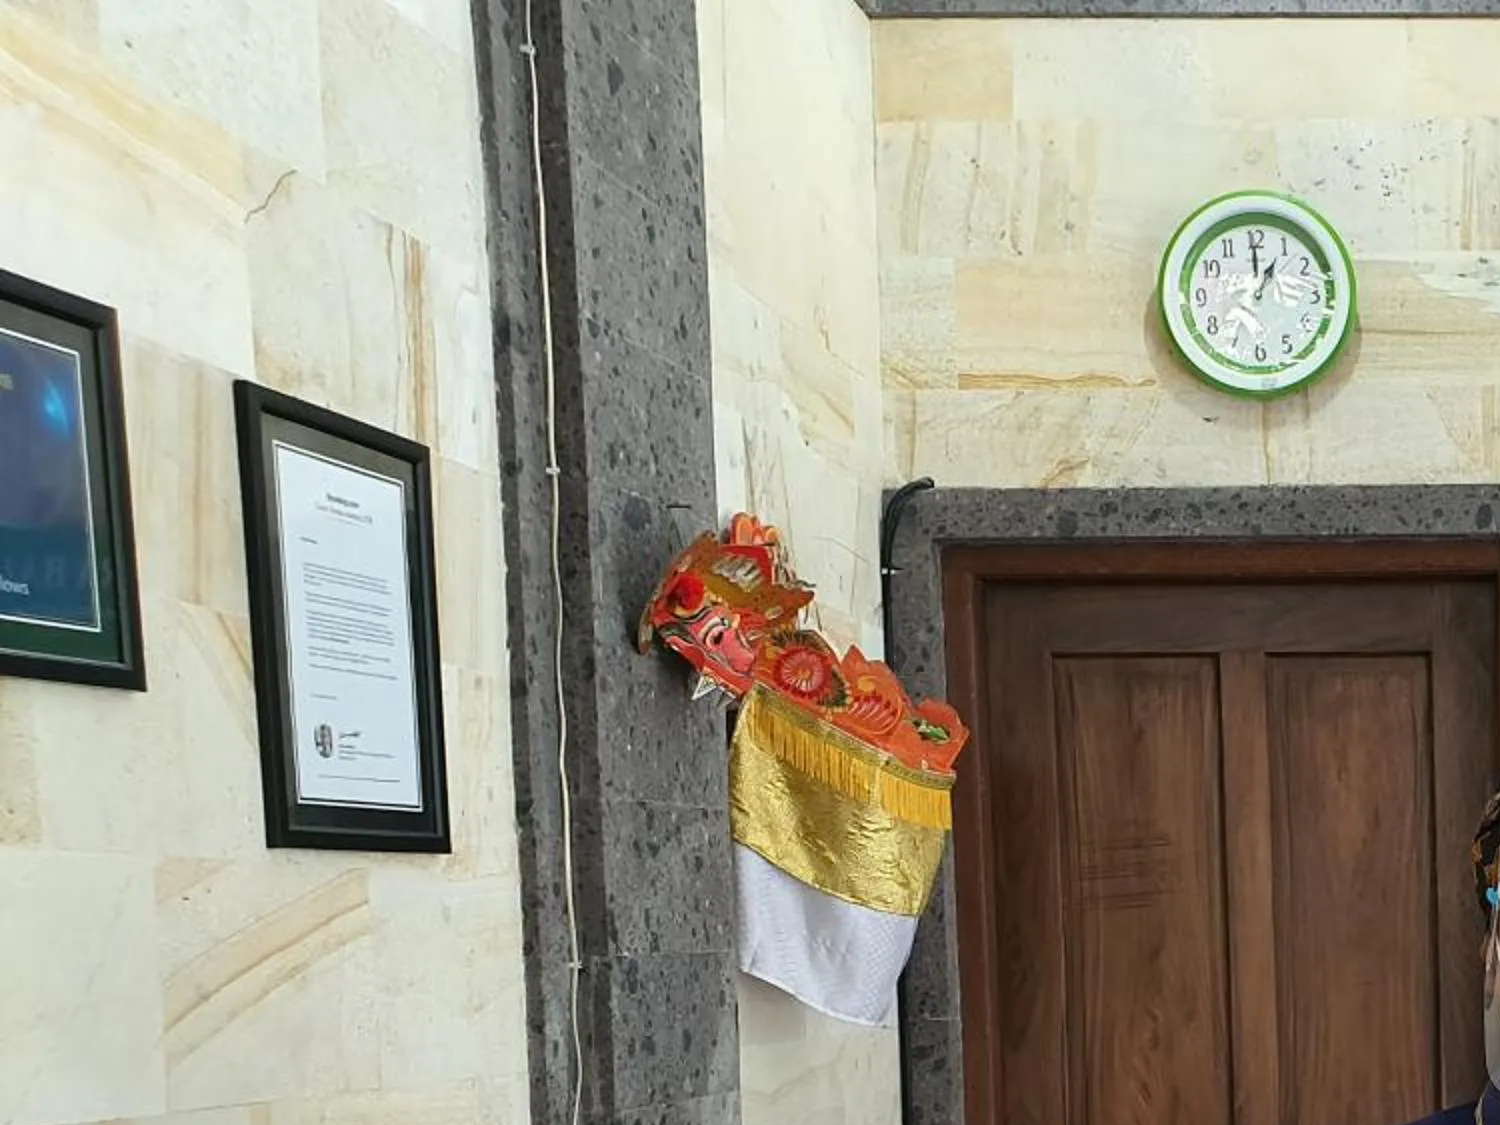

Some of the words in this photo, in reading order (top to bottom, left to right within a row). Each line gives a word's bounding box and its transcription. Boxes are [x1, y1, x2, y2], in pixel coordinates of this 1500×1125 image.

[1221, 238, 1235, 259] 11
[1247, 229, 1265, 250] 12
[1279, 236, 1289, 257] 1
[1202, 259, 1221, 279] 10
[1299, 256, 1310, 276] 2
[1195, 287, 1208, 308] 9
[1206, 315, 1219, 335] 8
[1254, 342, 1267, 362] 6
[1281, 334, 1294, 355] 5
